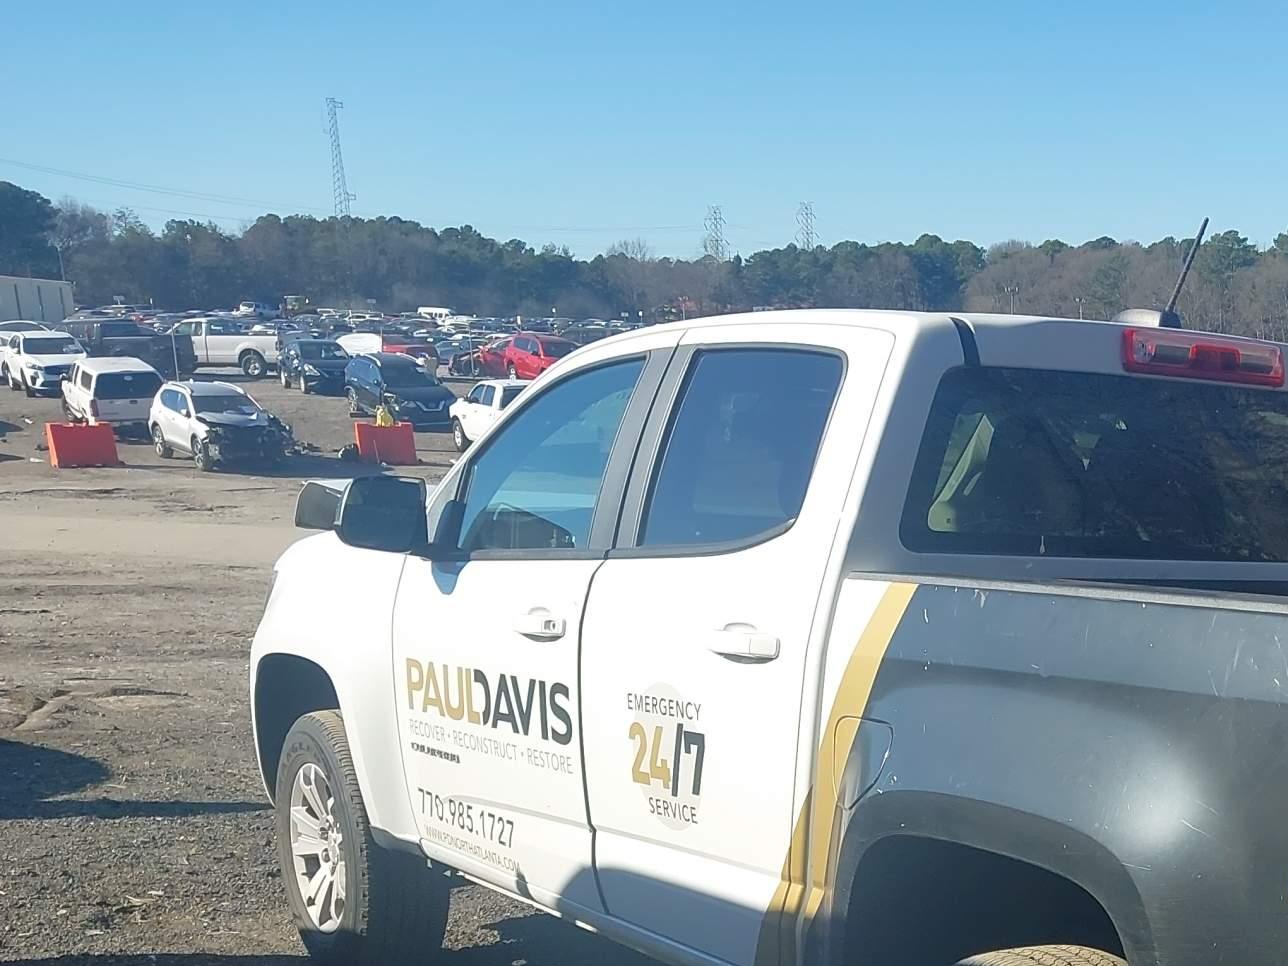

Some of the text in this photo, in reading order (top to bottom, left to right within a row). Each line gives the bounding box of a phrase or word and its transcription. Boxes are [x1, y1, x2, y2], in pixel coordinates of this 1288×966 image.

[627, 693, 701, 721] EMERGENCY
[409, 719, 445, 742] RECOVER
[452, 730, 517, 760] RECONSTRUCT
[527, 748, 574, 774] RESTORE
[418, 787, 515, 848] 770.985.1727
[648, 796, 698, 824] SERVICE
